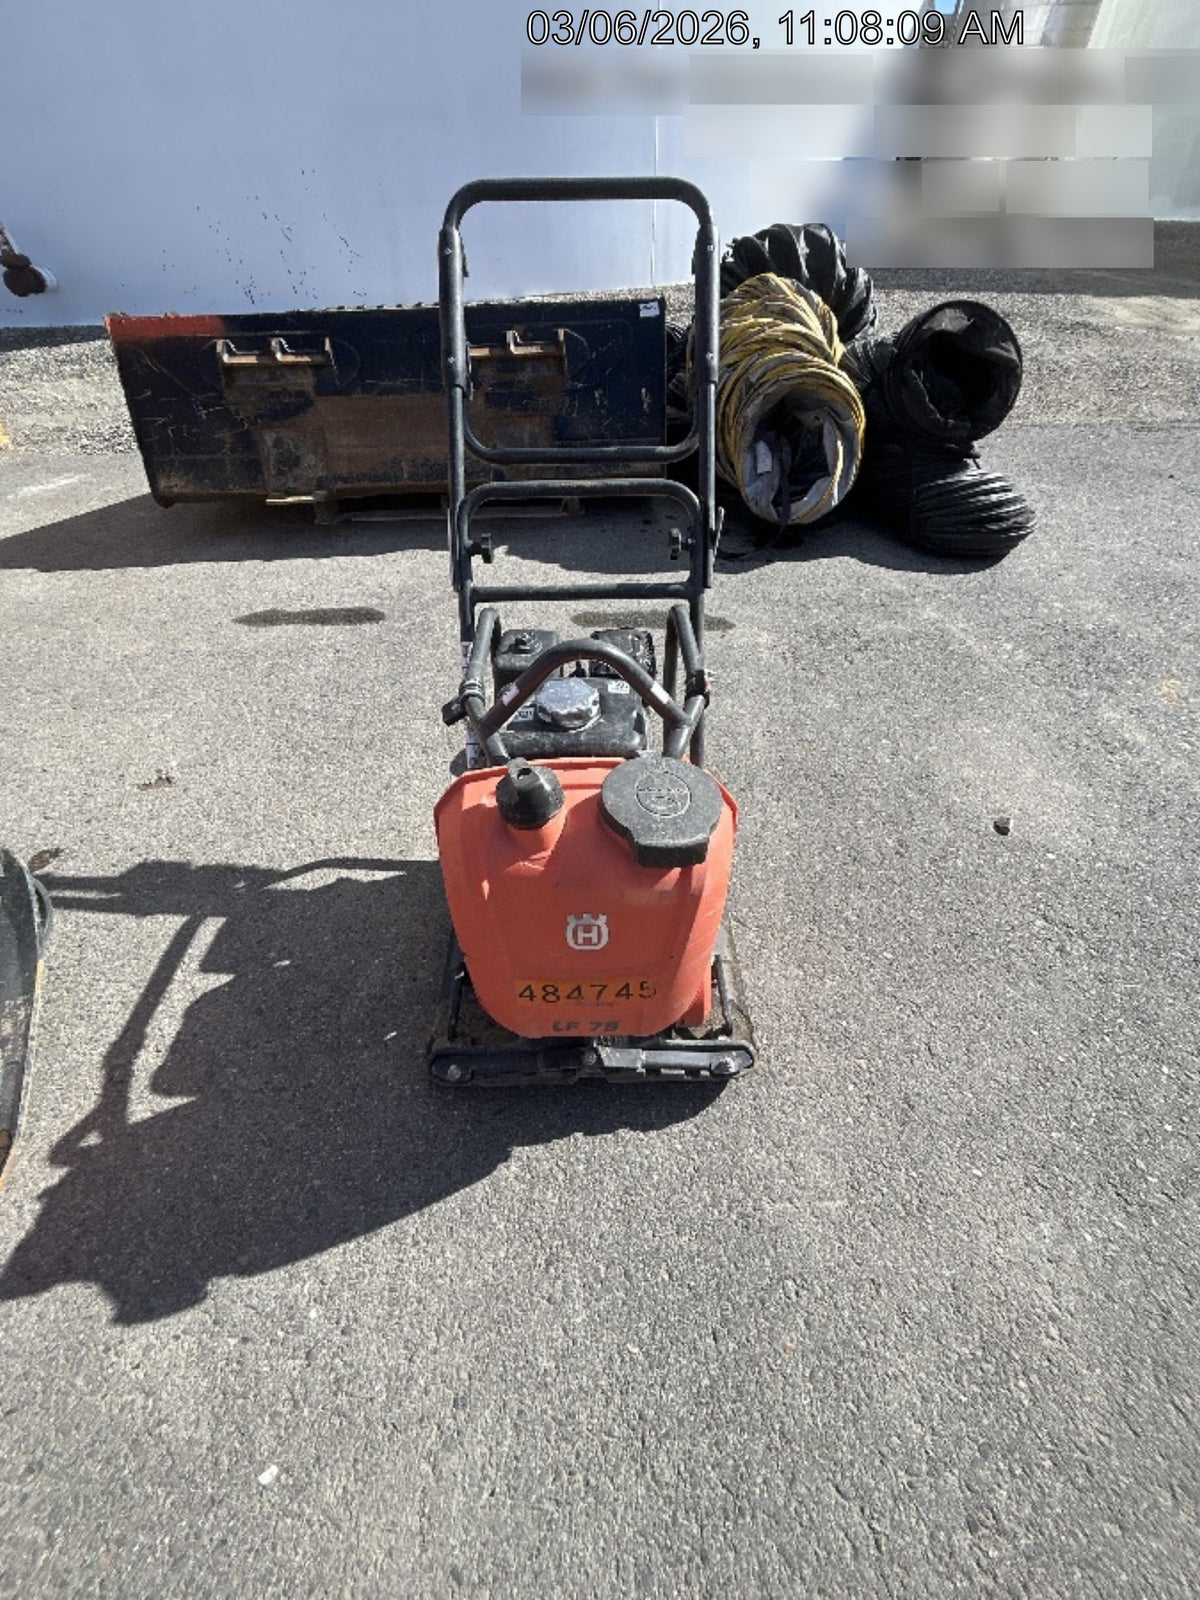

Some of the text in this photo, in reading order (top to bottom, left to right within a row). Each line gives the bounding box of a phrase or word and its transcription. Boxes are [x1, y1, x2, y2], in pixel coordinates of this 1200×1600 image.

[518, 980, 657, 1003] 484745
[552, 1020, 621, 1032] LF 75
